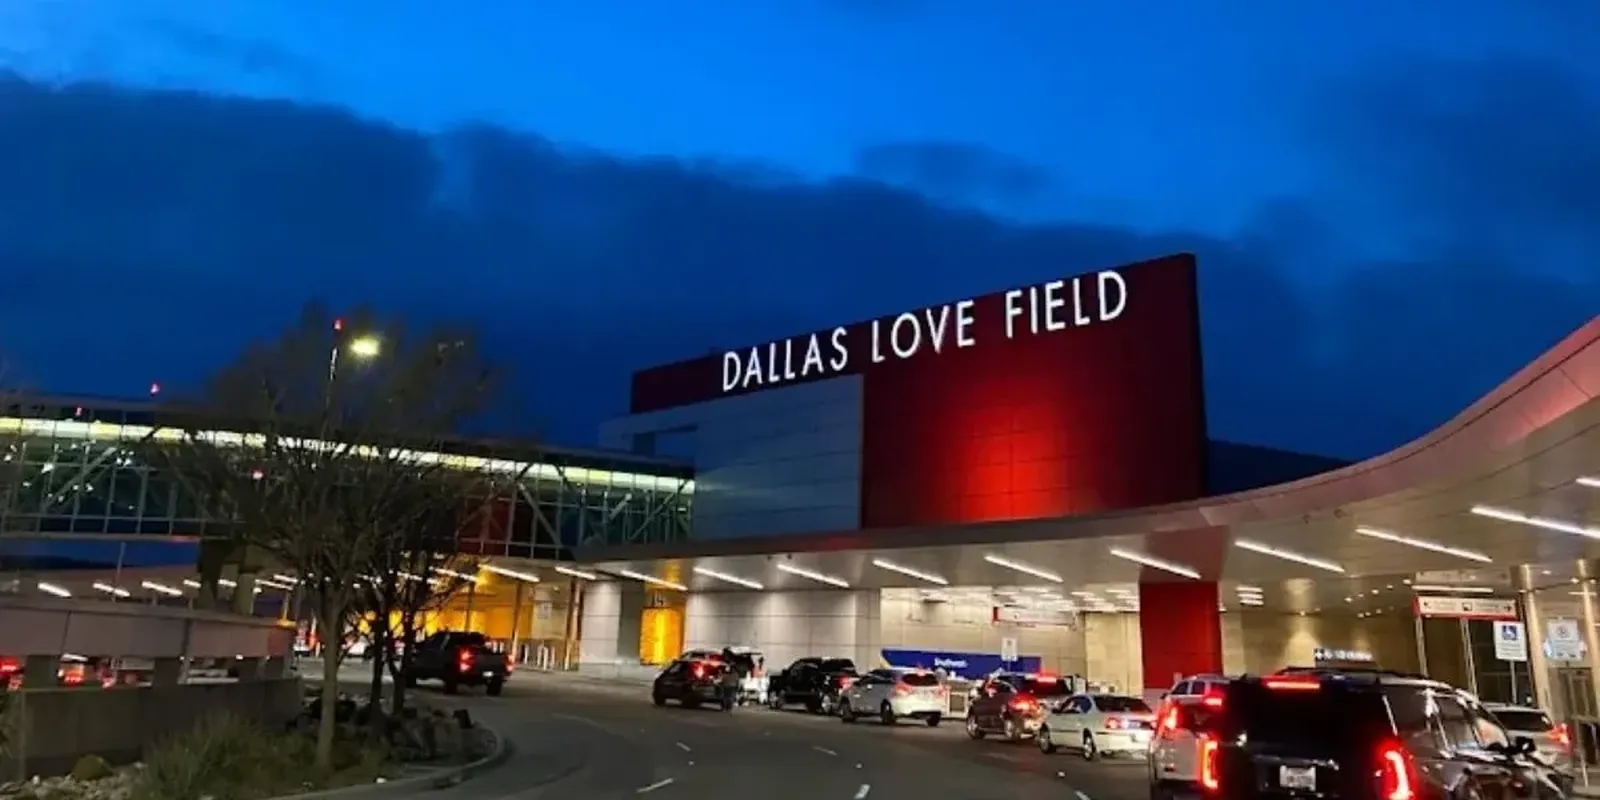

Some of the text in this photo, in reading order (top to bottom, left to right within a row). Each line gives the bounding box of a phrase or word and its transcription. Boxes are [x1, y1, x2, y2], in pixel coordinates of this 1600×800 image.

[722, 270, 1127, 392] DALLAS LOVE FIELD
